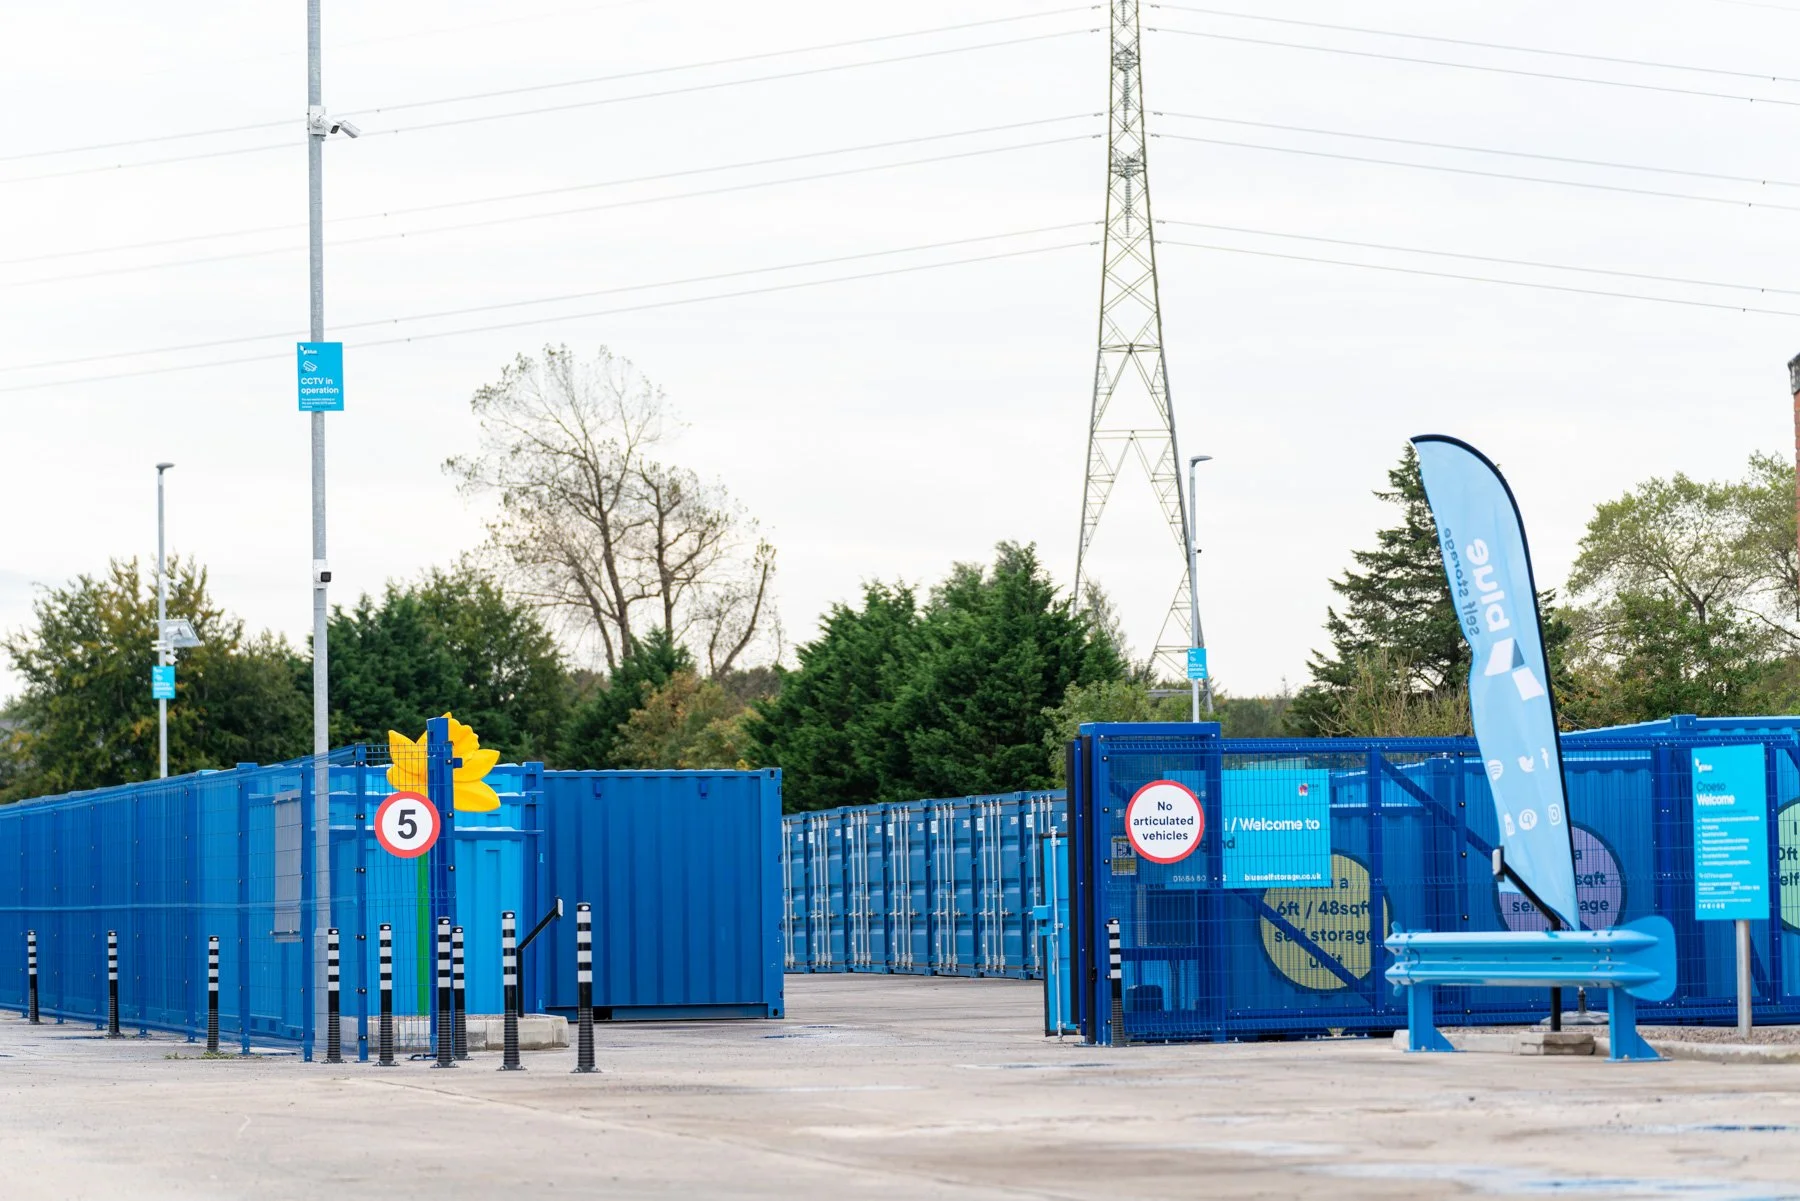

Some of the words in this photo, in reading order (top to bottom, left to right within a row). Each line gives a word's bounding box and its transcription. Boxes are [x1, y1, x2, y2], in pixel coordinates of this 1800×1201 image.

[301, 377, 324, 385] CCTV
[325, 377, 333, 385] in
[301, 386, 339, 395] operation
[1696, 781, 1726, 792] Croeso
[1696, 793, 1735, 806] Welcome
[1157, 802, 1173, 811] No
[397, 809, 418, 839] 5
[1133, 816, 1194, 826] articulated
[1239, 817, 1303, 831] Welcome
[1305, 818, 1320, 830] to
[1142, 831, 1188, 840] vehicles
[1576, 871, 1607, 888] sqft
[1277, 901, 1300, 917] 6ft
